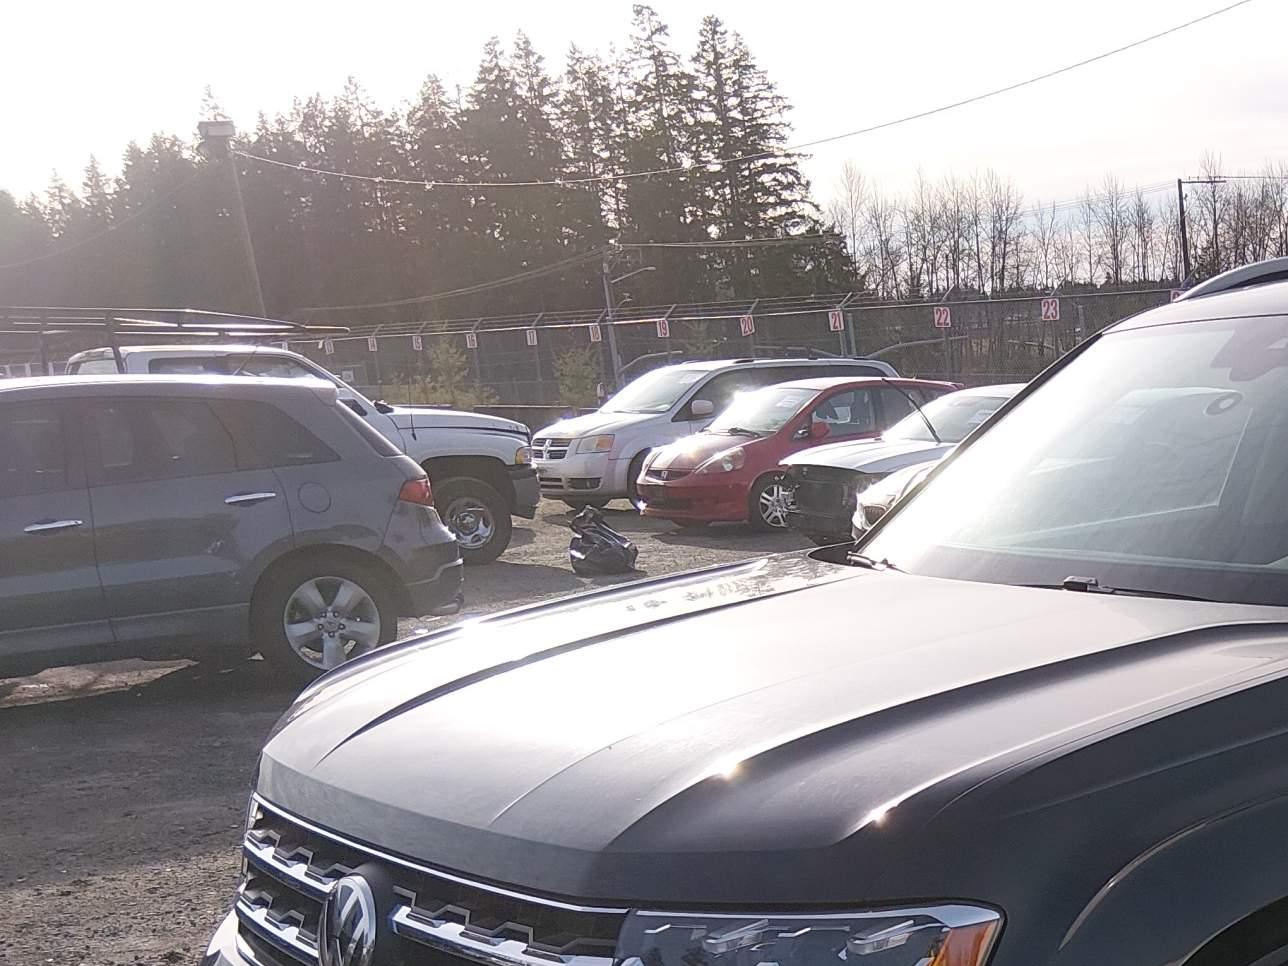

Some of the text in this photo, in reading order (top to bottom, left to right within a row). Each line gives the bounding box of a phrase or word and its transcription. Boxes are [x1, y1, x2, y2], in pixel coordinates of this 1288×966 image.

[936, 308, 950, 327] 22
[1042, 300, 1058, 320] 23
[658, 320, 668, 337] 19
[741, 316, 753, 336] 20
[831, 312, 842, 330] 21
